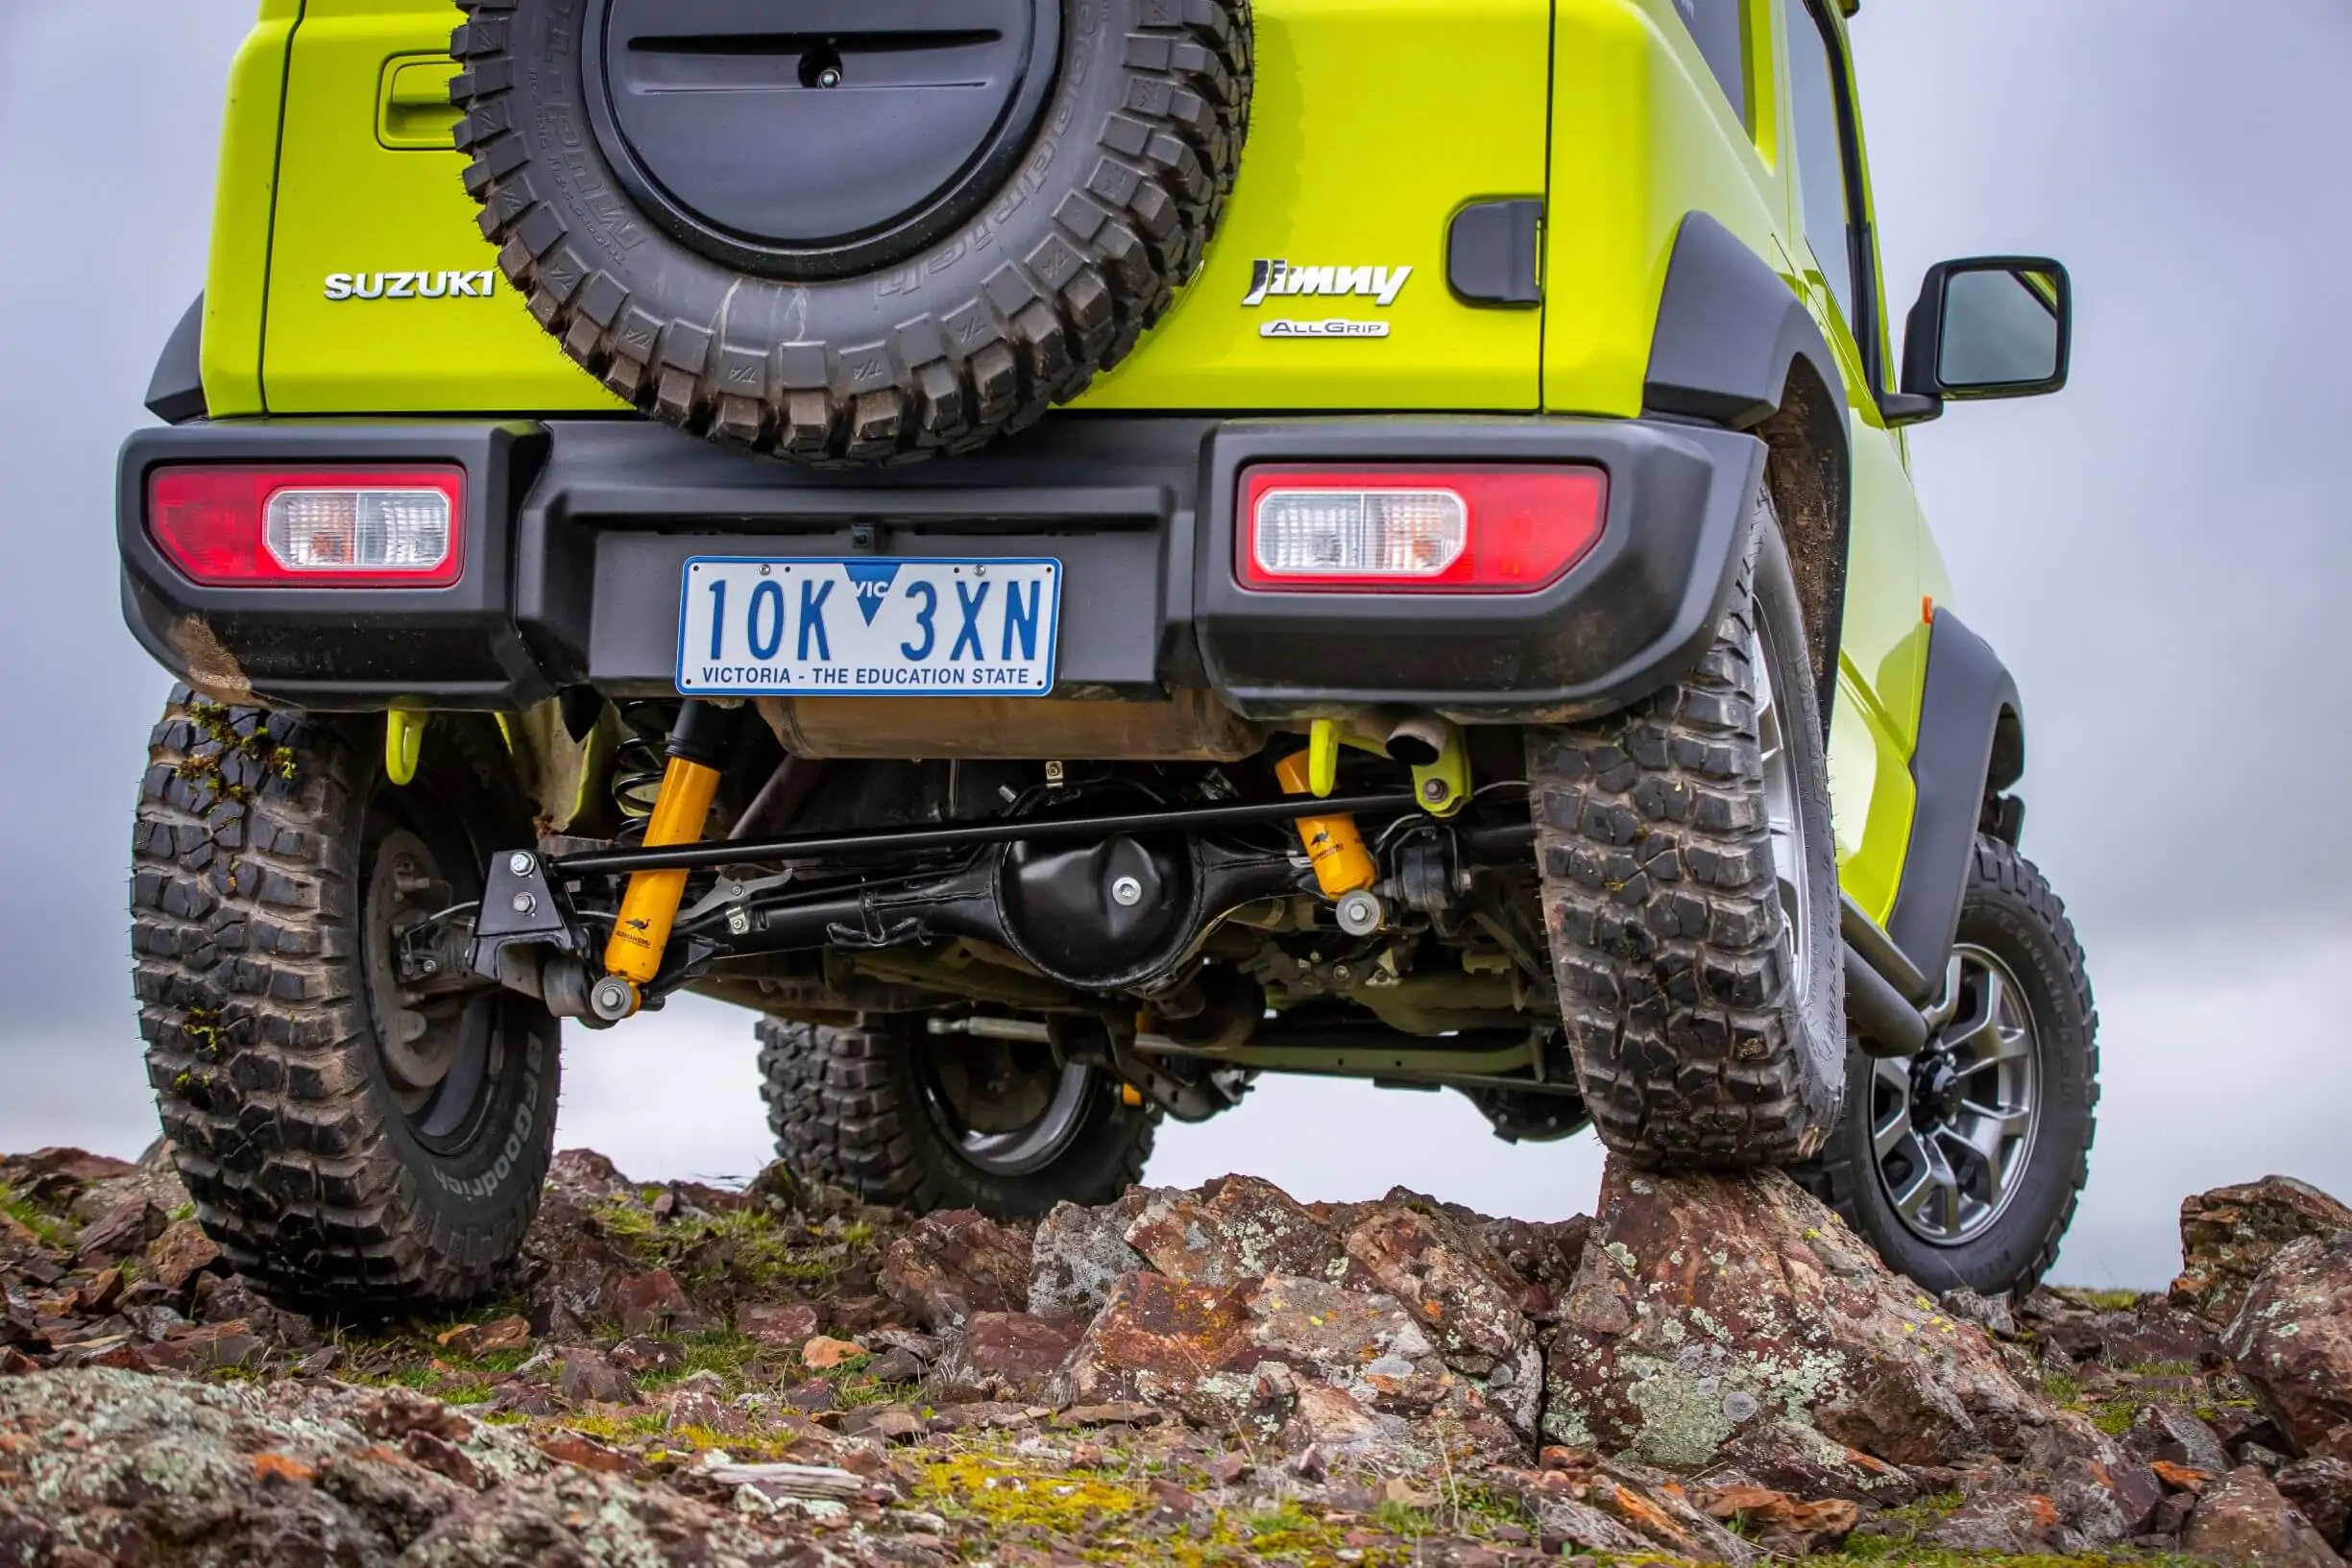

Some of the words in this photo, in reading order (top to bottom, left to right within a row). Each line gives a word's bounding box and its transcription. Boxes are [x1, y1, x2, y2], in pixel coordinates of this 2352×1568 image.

[324, 271, 495, 300] SUZUKI
[1241, 259, 1413, 305] Jimmy
[851, 581, 889, 598] VIC
[708, 579, 836, 662] 10K
[901, 580, 1041, 662] 3XN
[702, 667, 790, 684] VICTORIA
[812, 668, 849, 684] THE
[856, 667, 964, 685] EDUCATION
[972, 668, 1029, 684] STATE
